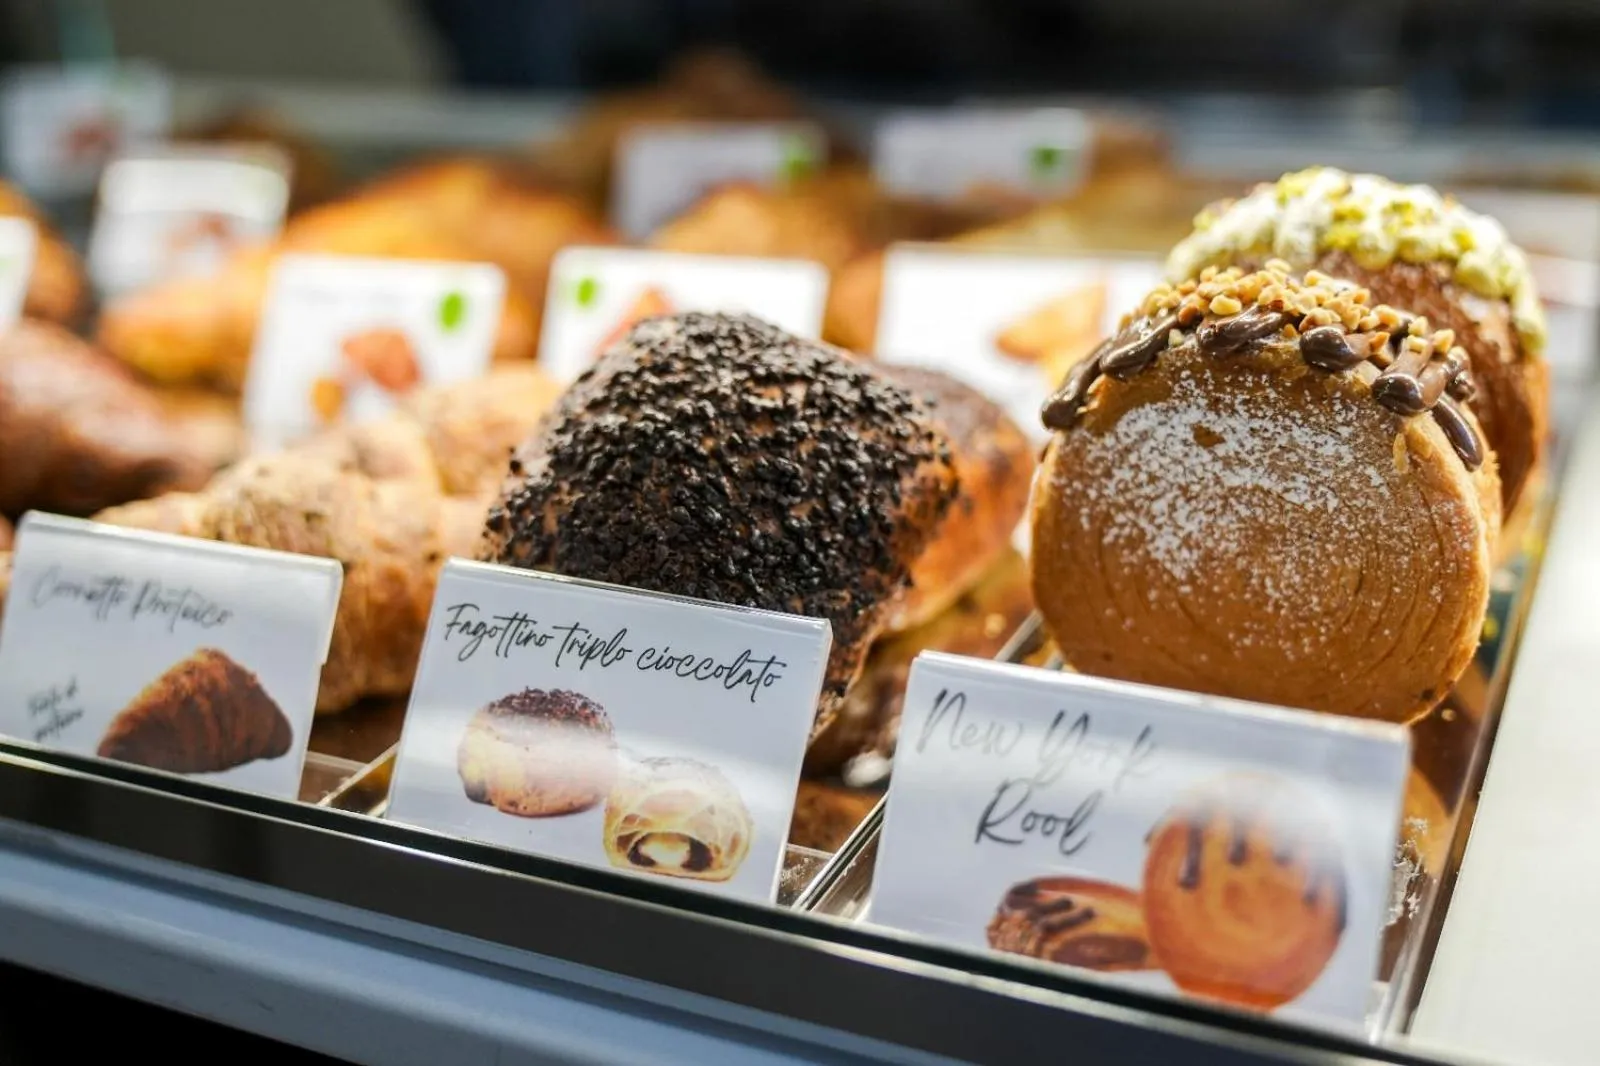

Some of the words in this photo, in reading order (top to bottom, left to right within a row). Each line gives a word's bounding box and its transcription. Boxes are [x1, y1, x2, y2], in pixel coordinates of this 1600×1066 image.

[445, 603, 553, 662] Fagottino
[552, 623, 632, 671] triplo
[636, 645, 787, 702] cioccolato
[916, 688, 1024, 758] New
[1030, 710, 1163, 792] York
